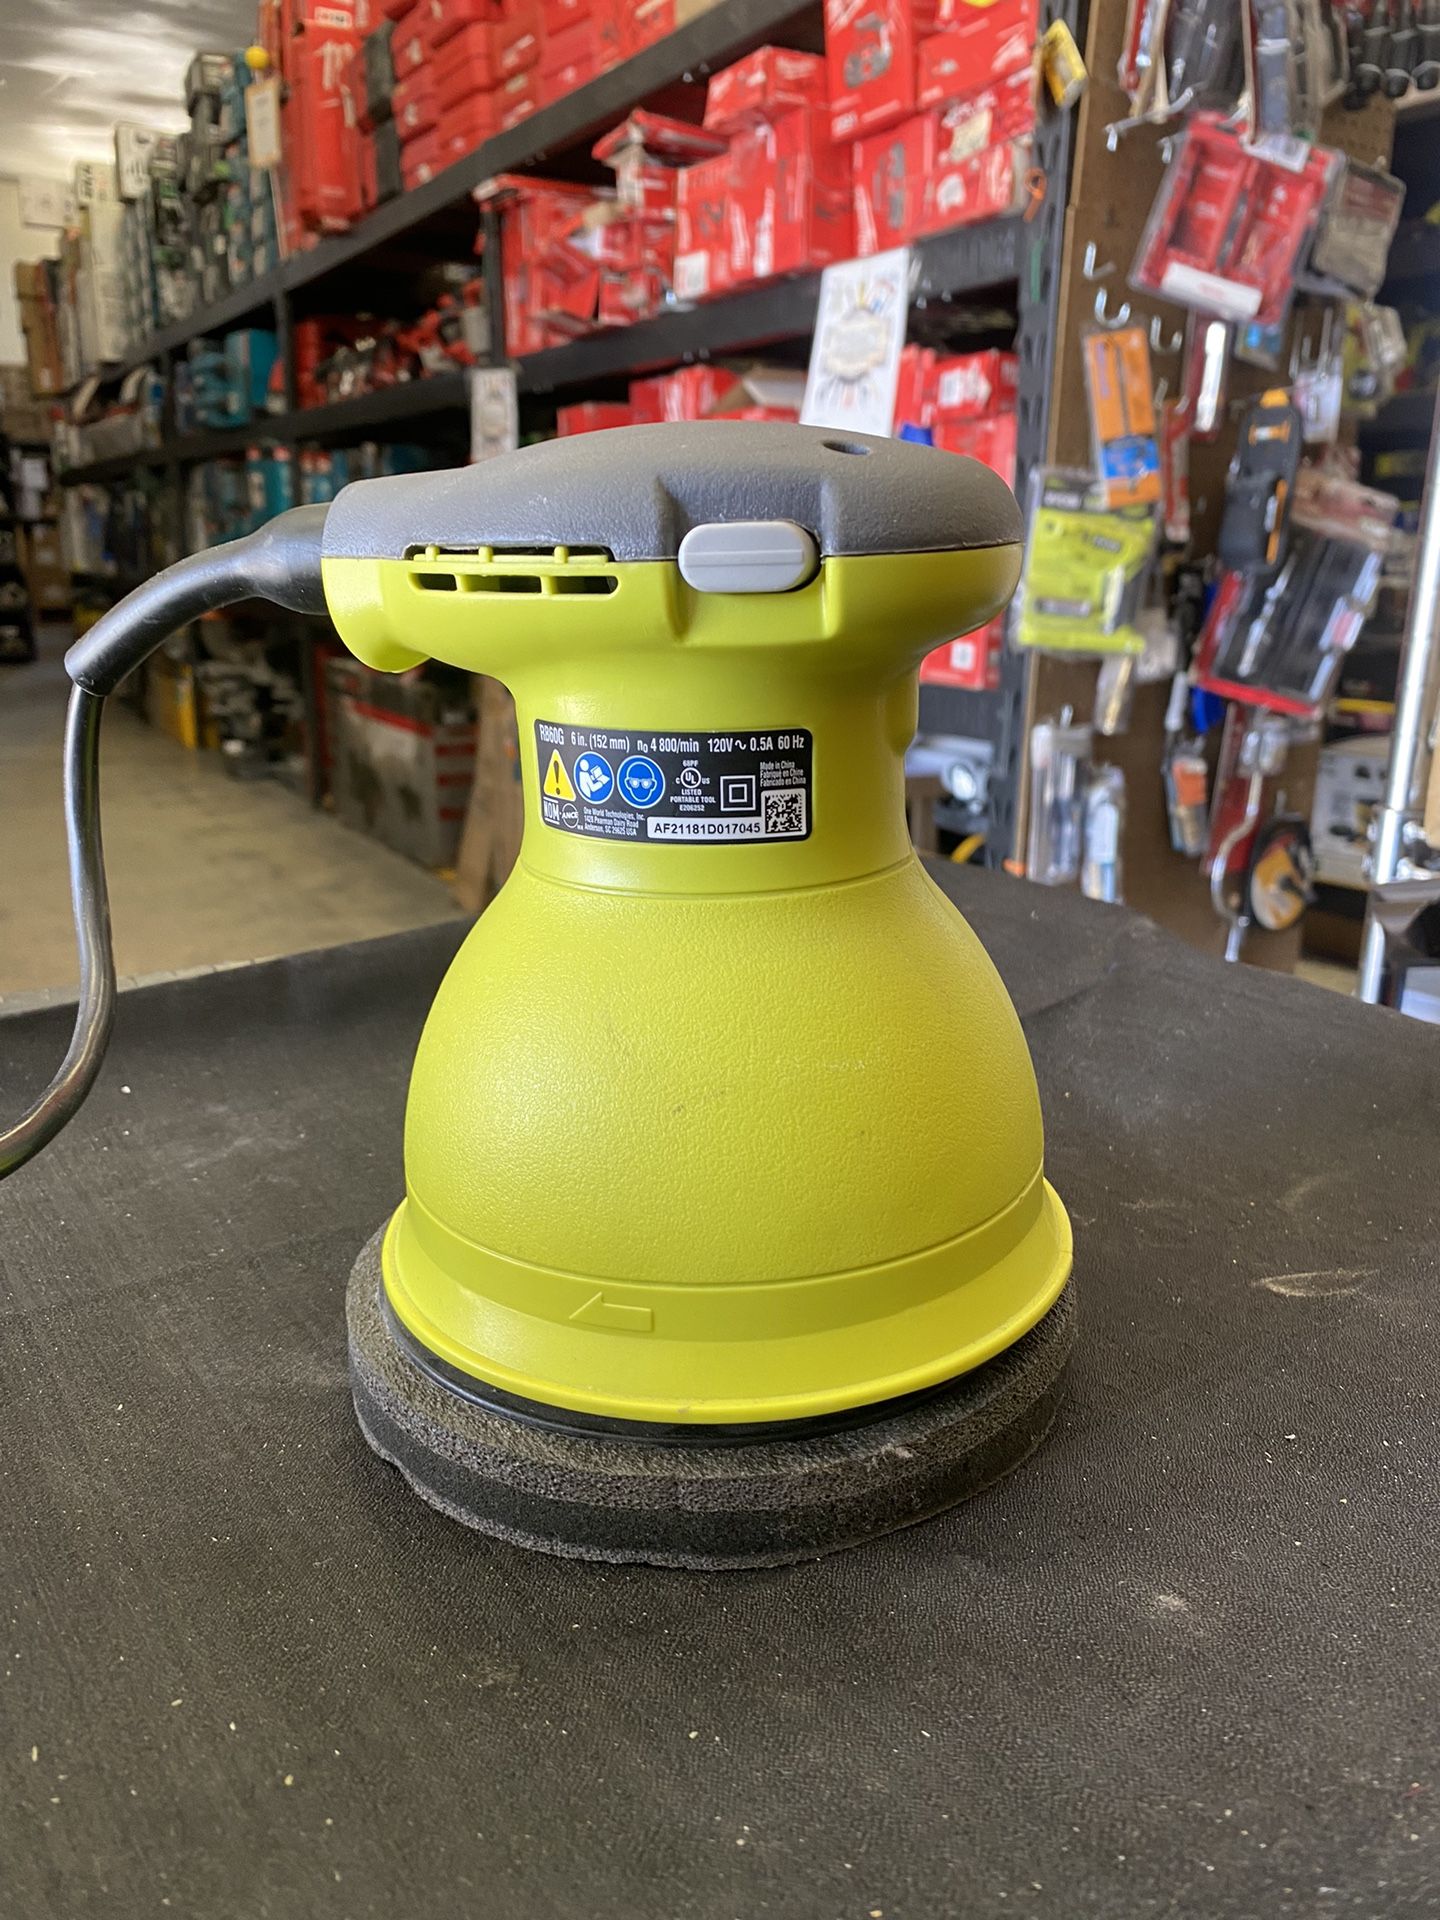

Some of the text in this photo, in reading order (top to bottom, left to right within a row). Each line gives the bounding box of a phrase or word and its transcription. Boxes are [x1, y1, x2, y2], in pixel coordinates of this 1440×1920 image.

[539, 724, 564, 745] RB60G
[571, 731, 576, 745] 6
[577, 732, 588, 747] in.
[590, 733, 608, 750] (152
[609, 736, 630, 753] mm)
[659, 738, 699, 754] 800/min
[707, 738, 733, 752] 120V
[750, 736, 773, 751] 0.5A
[777, 735, 790, 750] 60
[792, 734, 805, 749] Hz
[760, 761, 774, 769] Made
[781, 760, 795, 769] China
[790, 768, 804, 777] Chine
[760, 777, 784, 787] Fabricado
[792, 776, 806, 785] China
[681, 788, 702, 796] LISTED
[700, 796, 716, 804] TOOL
[543, 800, 560, 821] NOM
[561, 811, 579, 819] ANCE
[583, 806, 592, 815] One
[592, 808, 604, 817] World
[636, 812, 645, 821] Inc.
[614, 818, 625, 827] Dairy
[626, 820, 639, 828] Road
[654, 822, 761, 834] AF21181D017045
[585, 823, 604, 833] Anderson,
[605, 825, 611, 834] SC
[626, 827, 637, 836] USA
